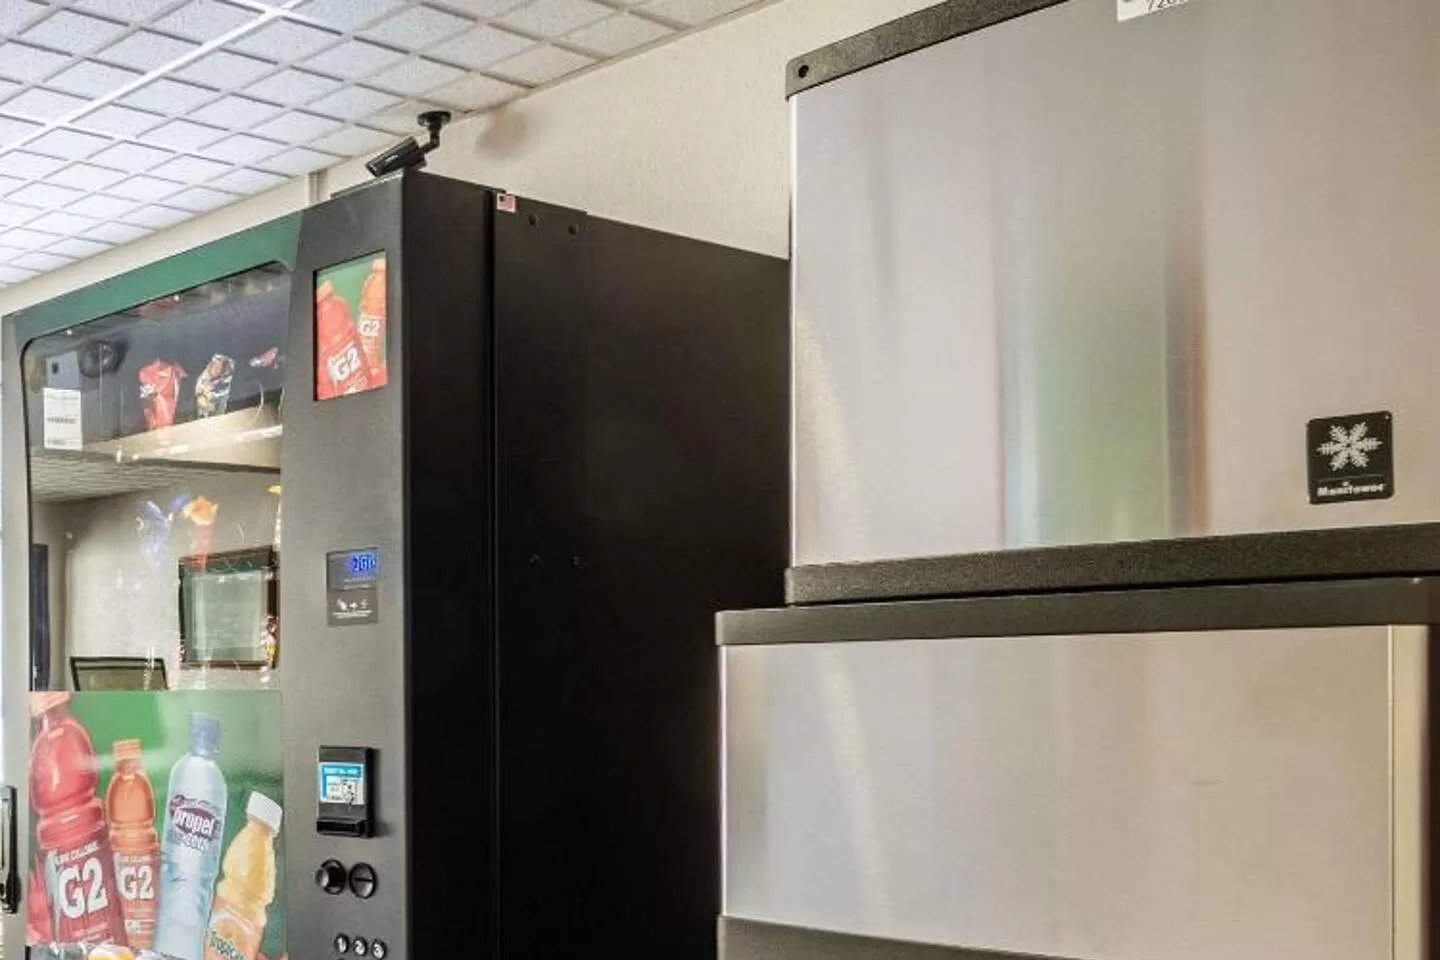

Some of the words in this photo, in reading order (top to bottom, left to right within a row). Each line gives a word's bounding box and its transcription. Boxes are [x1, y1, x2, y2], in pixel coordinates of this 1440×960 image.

[172, 810, 215, 837] propel
[59, 857, 108, 918] G2
[120, 865, 154, 901] G2
